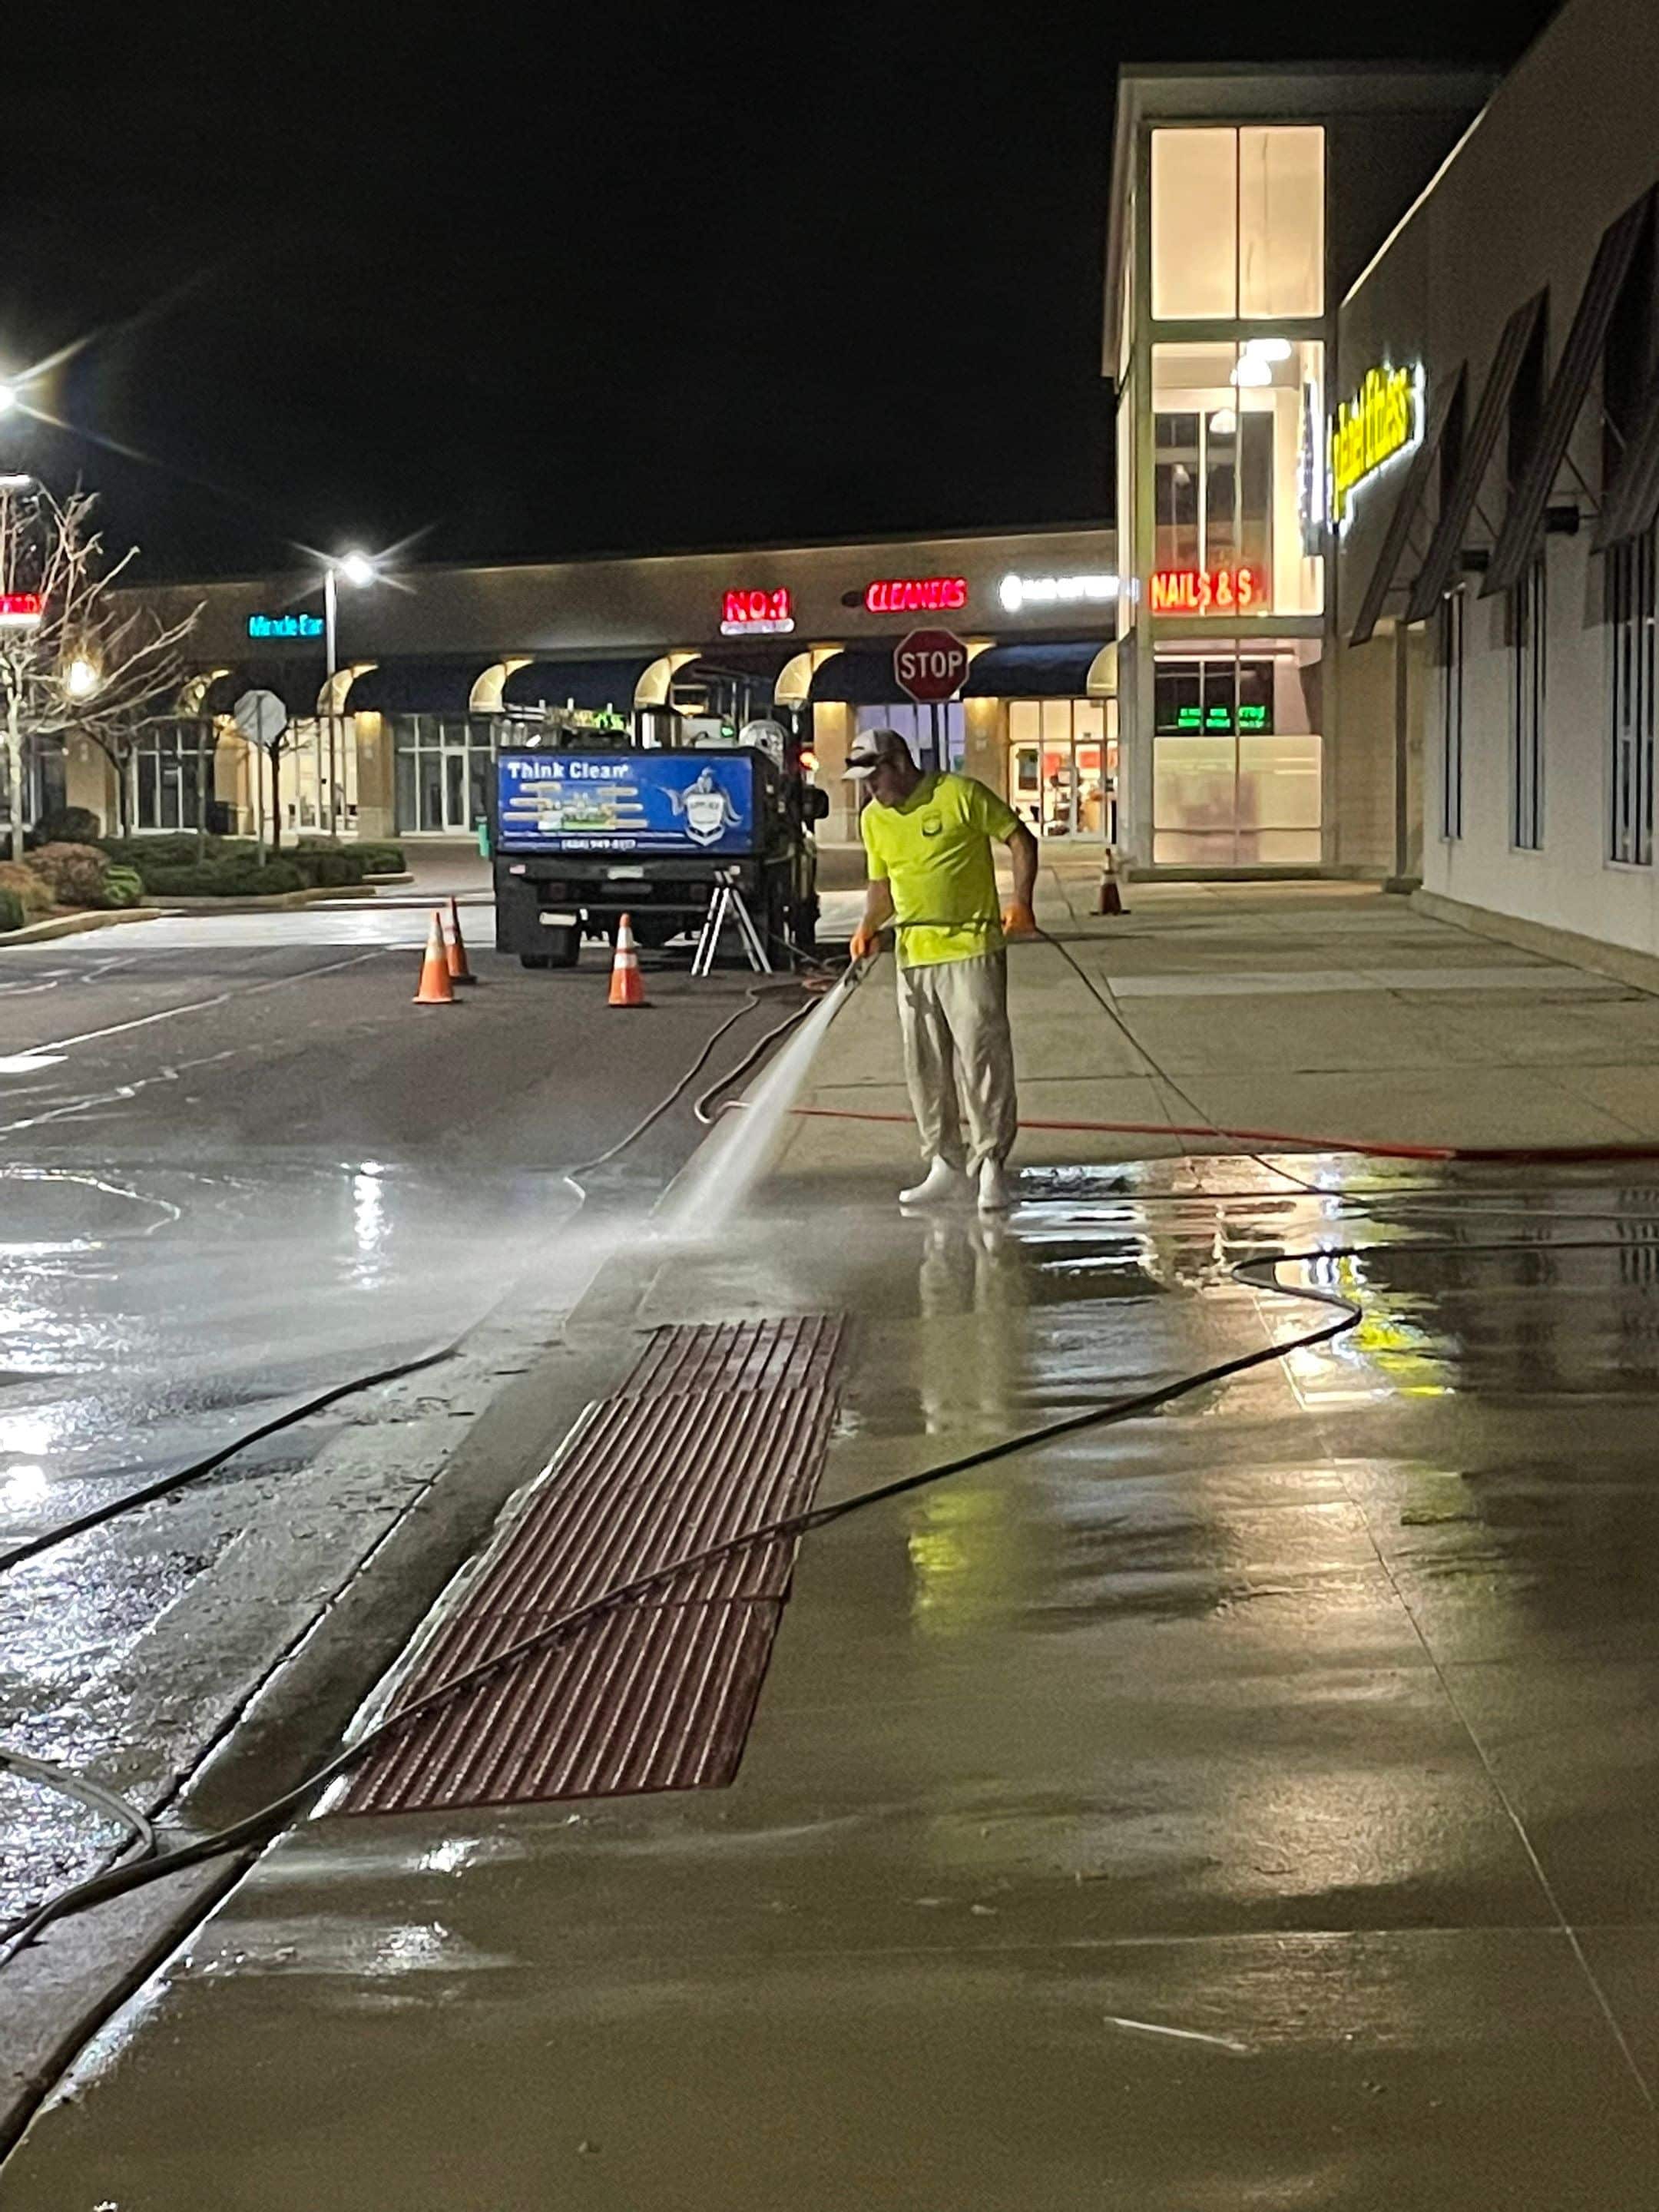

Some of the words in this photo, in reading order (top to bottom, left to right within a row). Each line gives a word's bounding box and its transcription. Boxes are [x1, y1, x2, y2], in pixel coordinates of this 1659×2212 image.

[866, 579, 965, 612] CLEANERS
[1152, 572, 1211, 610] NAILS
[1217, 571, 1233, 606] &
[901, 651, 963, 680] STOP
[507, 762, 565, 779] Think
[569, 762, 626, 779] Clean
